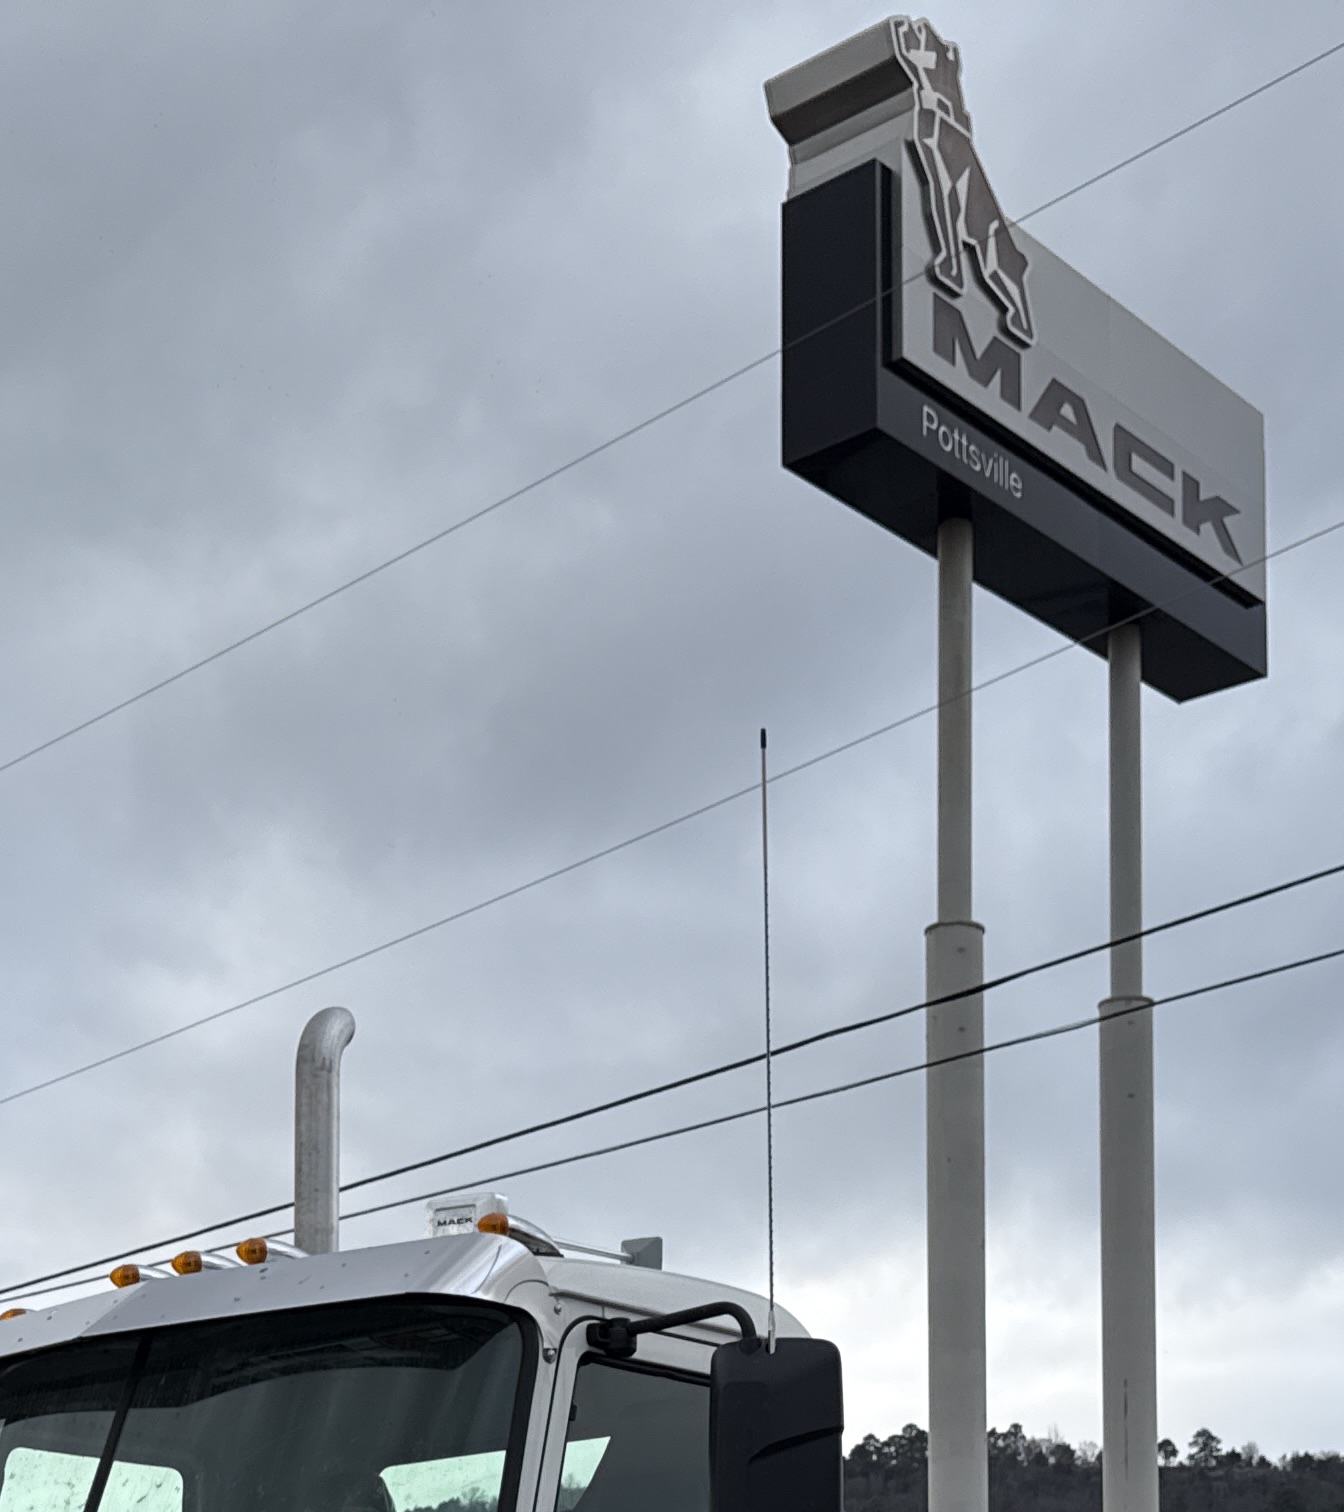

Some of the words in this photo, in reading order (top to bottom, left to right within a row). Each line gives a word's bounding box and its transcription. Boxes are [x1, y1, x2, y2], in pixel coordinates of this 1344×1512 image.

[921, 403, 1023, 499] Pottsville
[932, 291, 1243, 567] MACK
[436, 1216, 473, 1227] MACK
